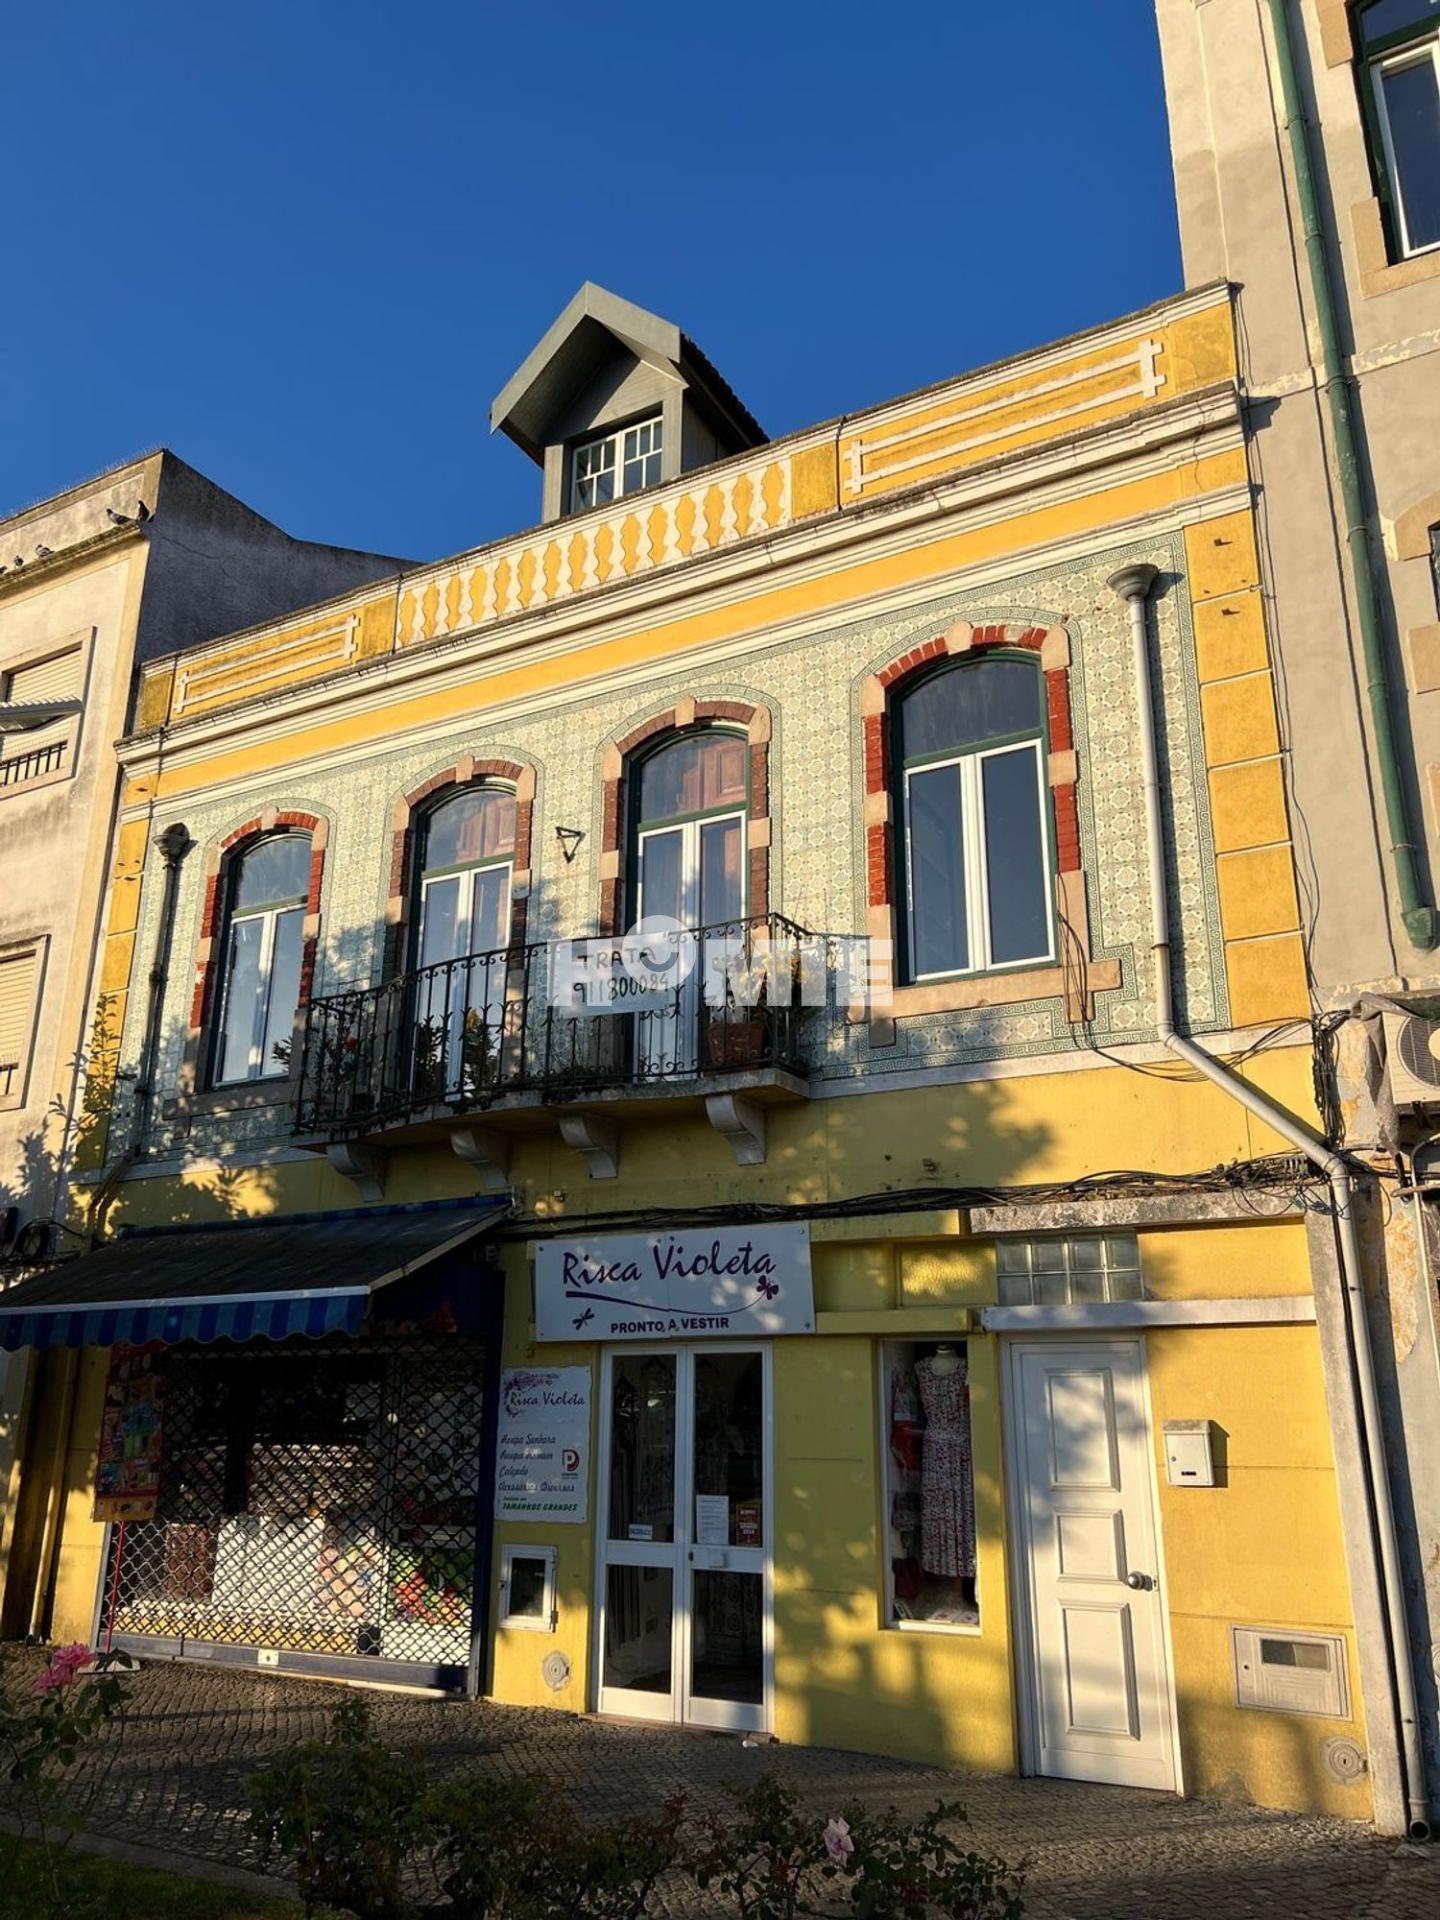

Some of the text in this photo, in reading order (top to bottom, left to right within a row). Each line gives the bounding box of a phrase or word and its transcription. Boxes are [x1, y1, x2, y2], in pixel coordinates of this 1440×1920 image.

[577, 947, 657, 970] TRATA
[563, 1240, 776, 1288] Risca Violeta
[610, 1317, 729, 1333] PRONTO A VESTIR
[543, 1390, 585, 1406] Violeta
